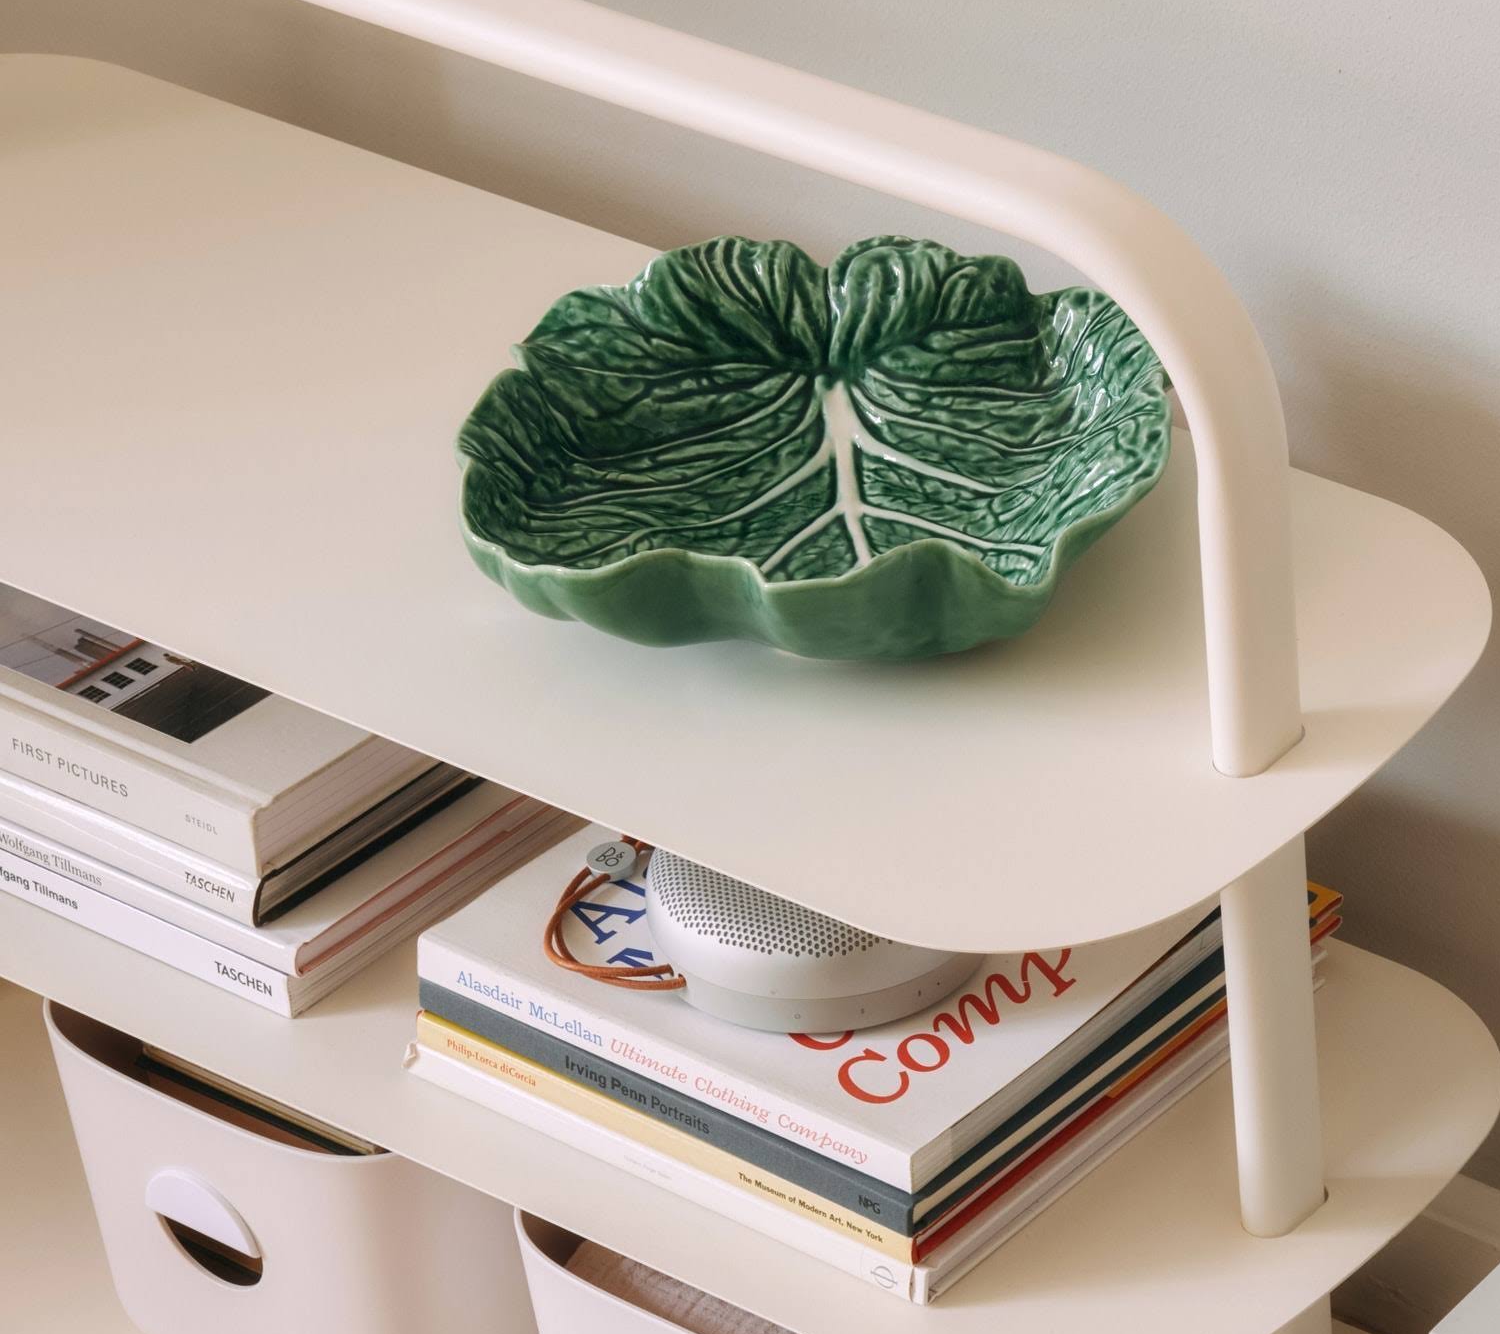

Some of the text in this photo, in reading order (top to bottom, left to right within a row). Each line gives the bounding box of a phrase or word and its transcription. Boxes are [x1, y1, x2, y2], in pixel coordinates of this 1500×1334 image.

[12, 738, 128, 797] FIRST PICTURES
[185, 814, 218, 835] STEIDL
[51, 854, 102, 887] Tillmans
[184, 871, 235, 903] TASCHEN
[32, 880, 78, 910] Tillmans
[215, 961, 273, 998] TASCHEN
[447, 1038, 536, 1087] Philip-Lorca diCorcia
[457, 970, 869, 1165] Alasdair McLellan Ultimate Clothing Company
[565, 1055, 710, 1135] Irving Penn Portraits
[738, 1171, 752, 1185] The
[755, 1179, 786, 1200] Museum
[788, 1193, 797, 1204] of
[798, 1199, 827, 1219] Modern
[846, 1221, 863, 1234] New
[865, 1228, 883, 1244] York
[858, 1194, 881, 1215] NPG
